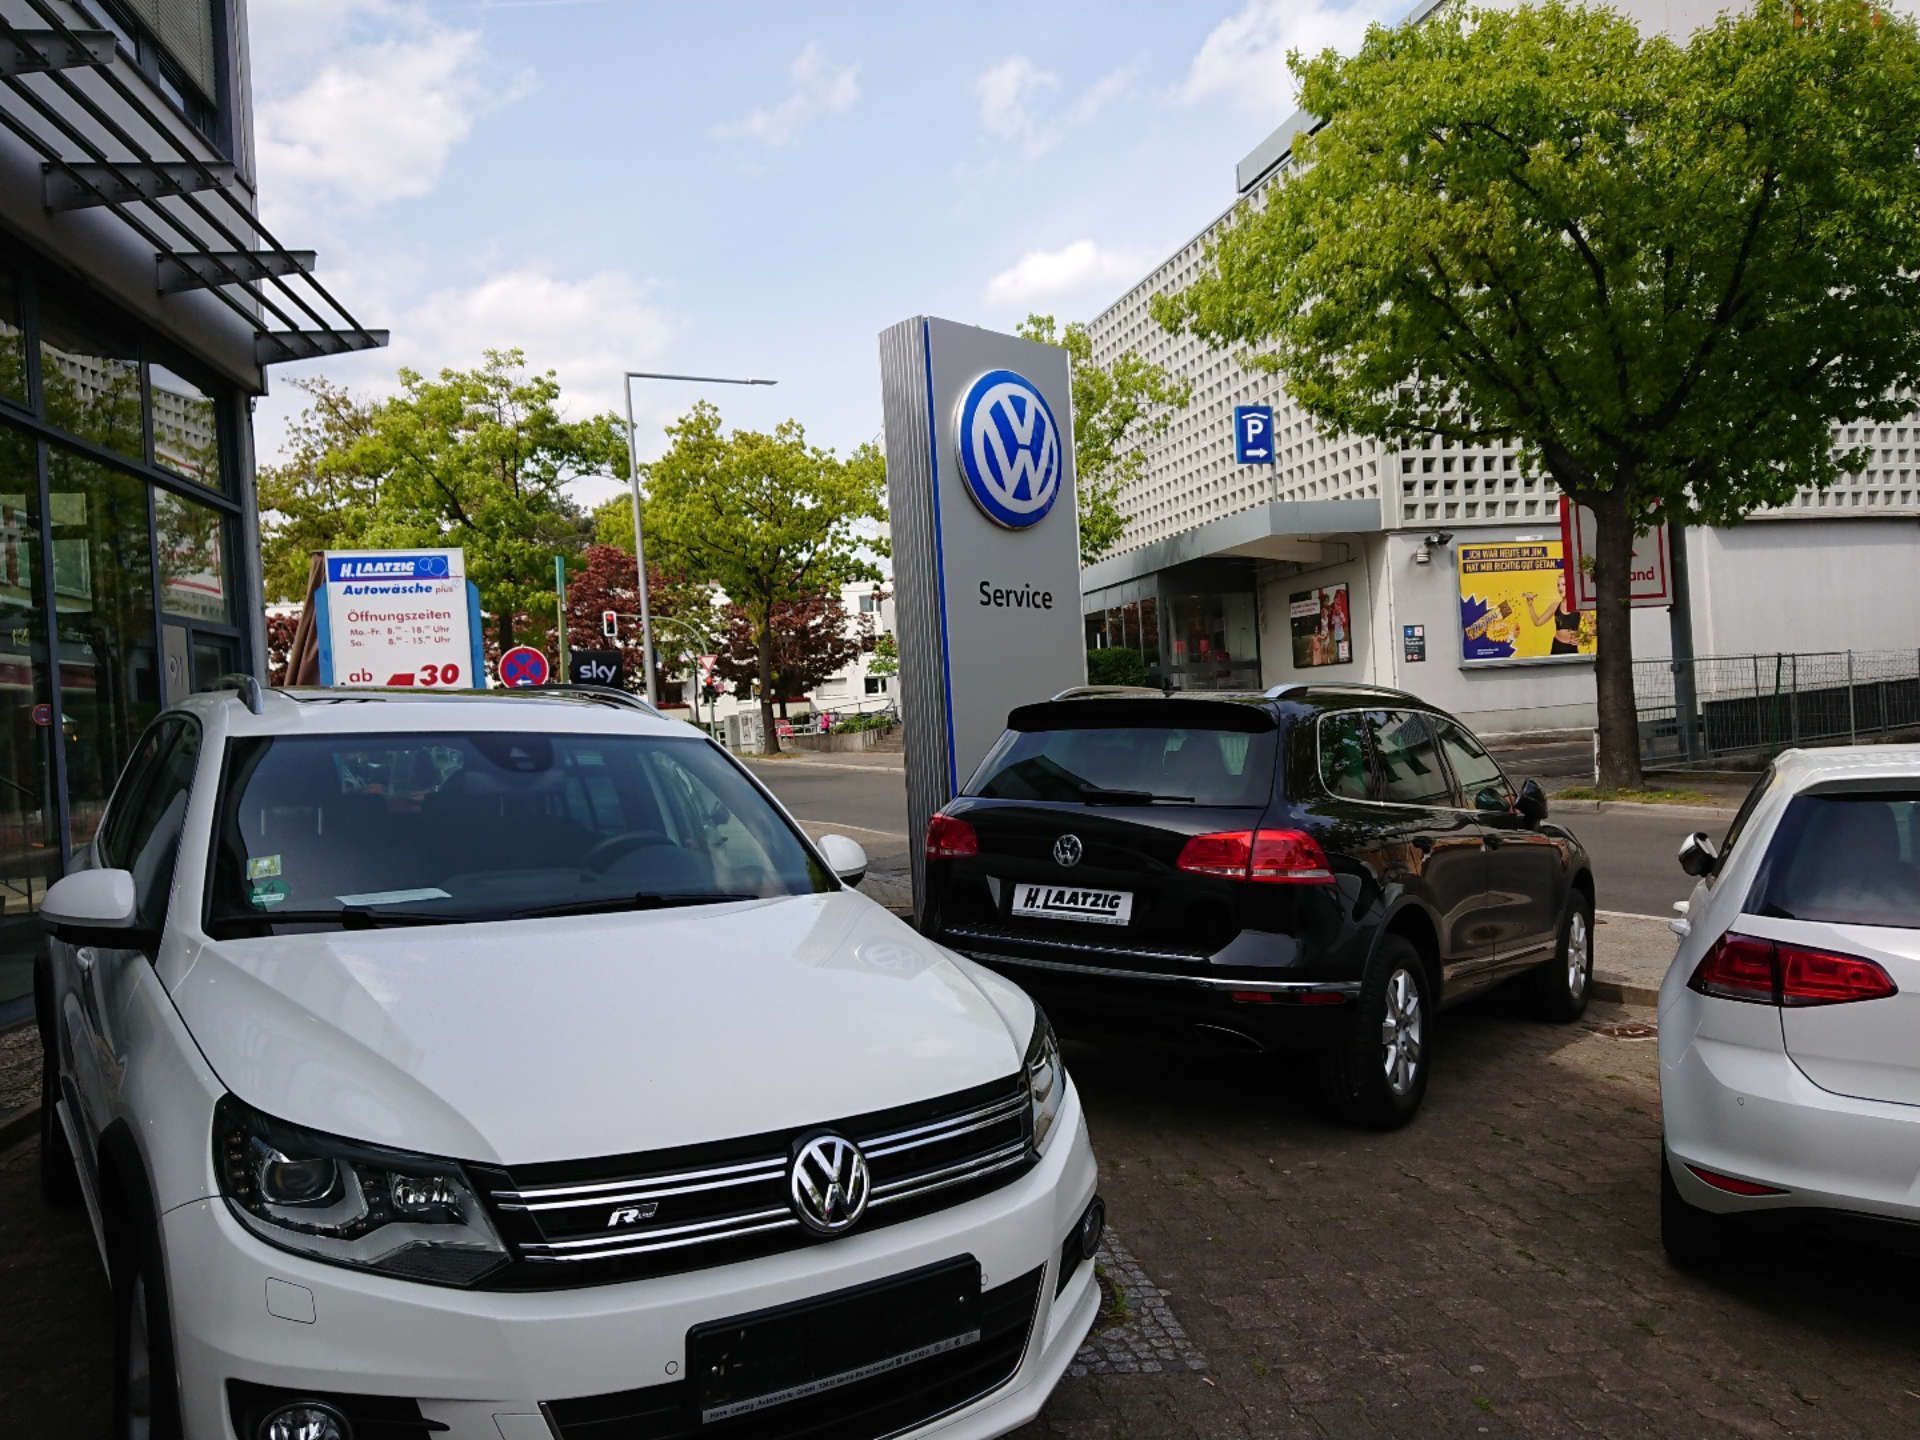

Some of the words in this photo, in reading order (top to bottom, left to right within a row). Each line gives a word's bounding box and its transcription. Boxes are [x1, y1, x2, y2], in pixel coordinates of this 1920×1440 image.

[1247, 419, 1264, 443] P
[343, 582, 433, 595] Autowäsche
[979, 580, 1053, 609] Service
[347, 608, 452, 623] Öffnungszeiten
[432, 625, 450, 633] Uhr
[433, 635, 451, 644] Uhr
[349, 668, 373, 683] ab
[579, 659, 617, 684] sky
